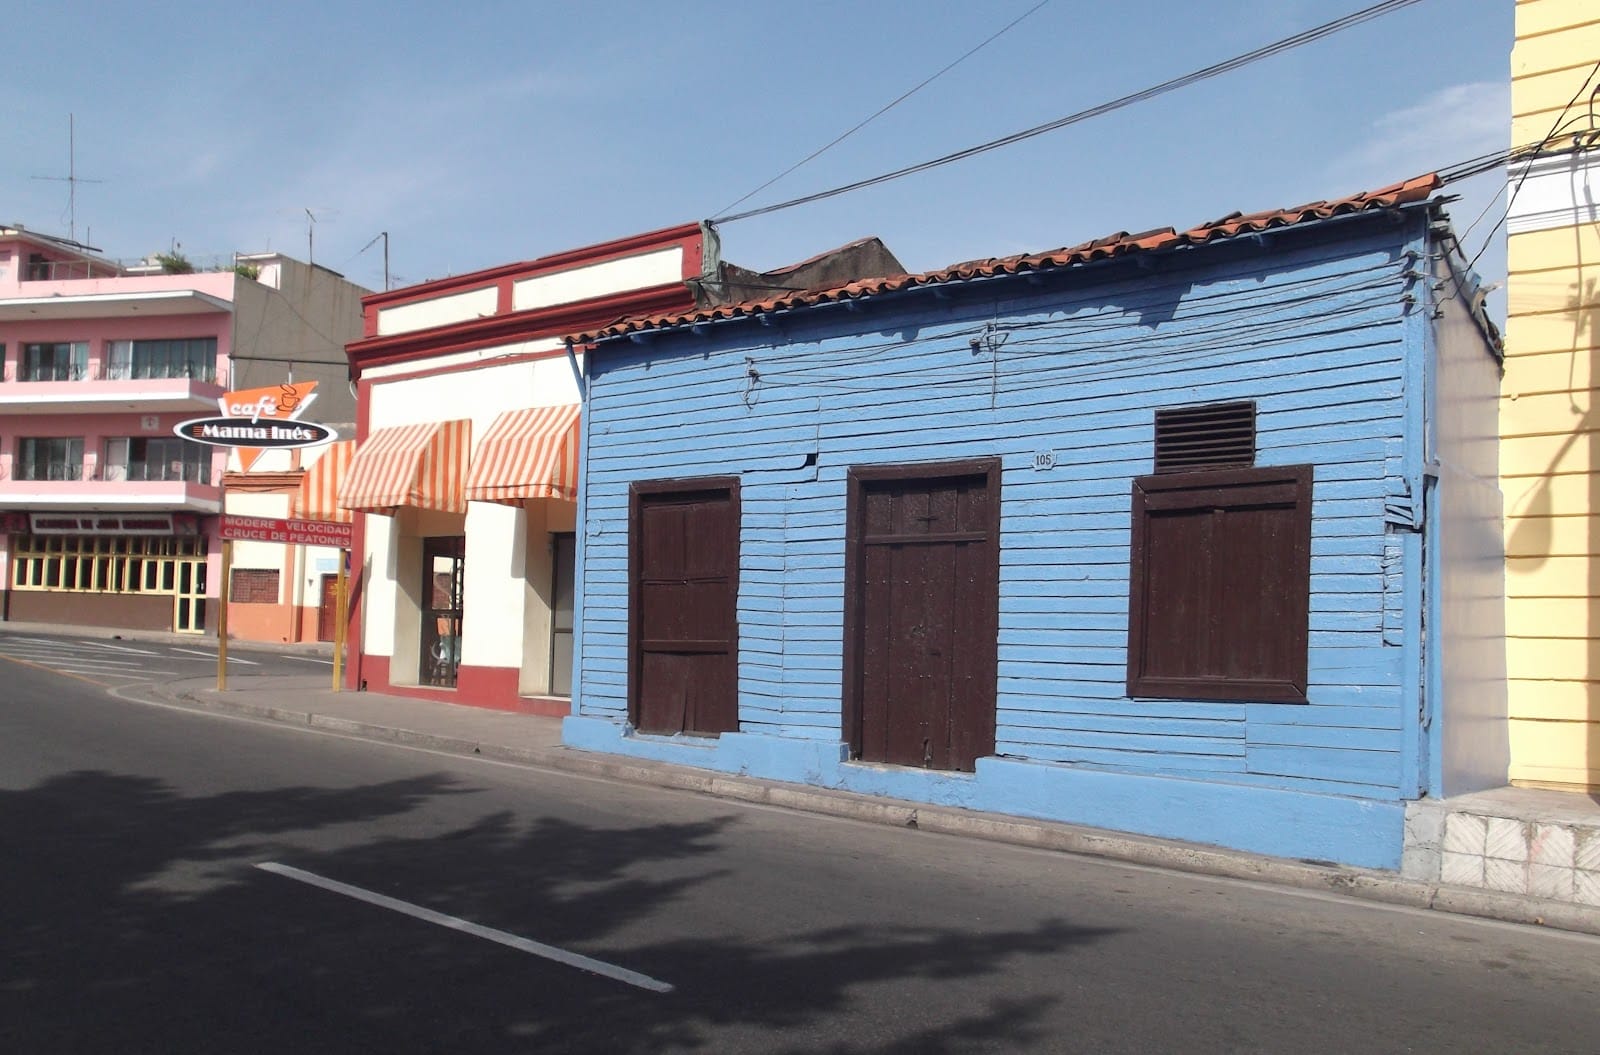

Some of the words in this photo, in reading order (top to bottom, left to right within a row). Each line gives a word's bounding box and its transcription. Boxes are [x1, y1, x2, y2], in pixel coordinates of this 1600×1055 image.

[230, 395, 277, 424] café
[202, 424, 266, 439] Mama
[1036, 454, 1051, 465] 105
[224, 517, 276, 530] MODERE
[286, 522, 351, 535] VELOCIDAD
[224, 528, 267, 539] CRUCE
[271, 531, 287, 540] DE
[289, 533, 350, 546] PEATONES
